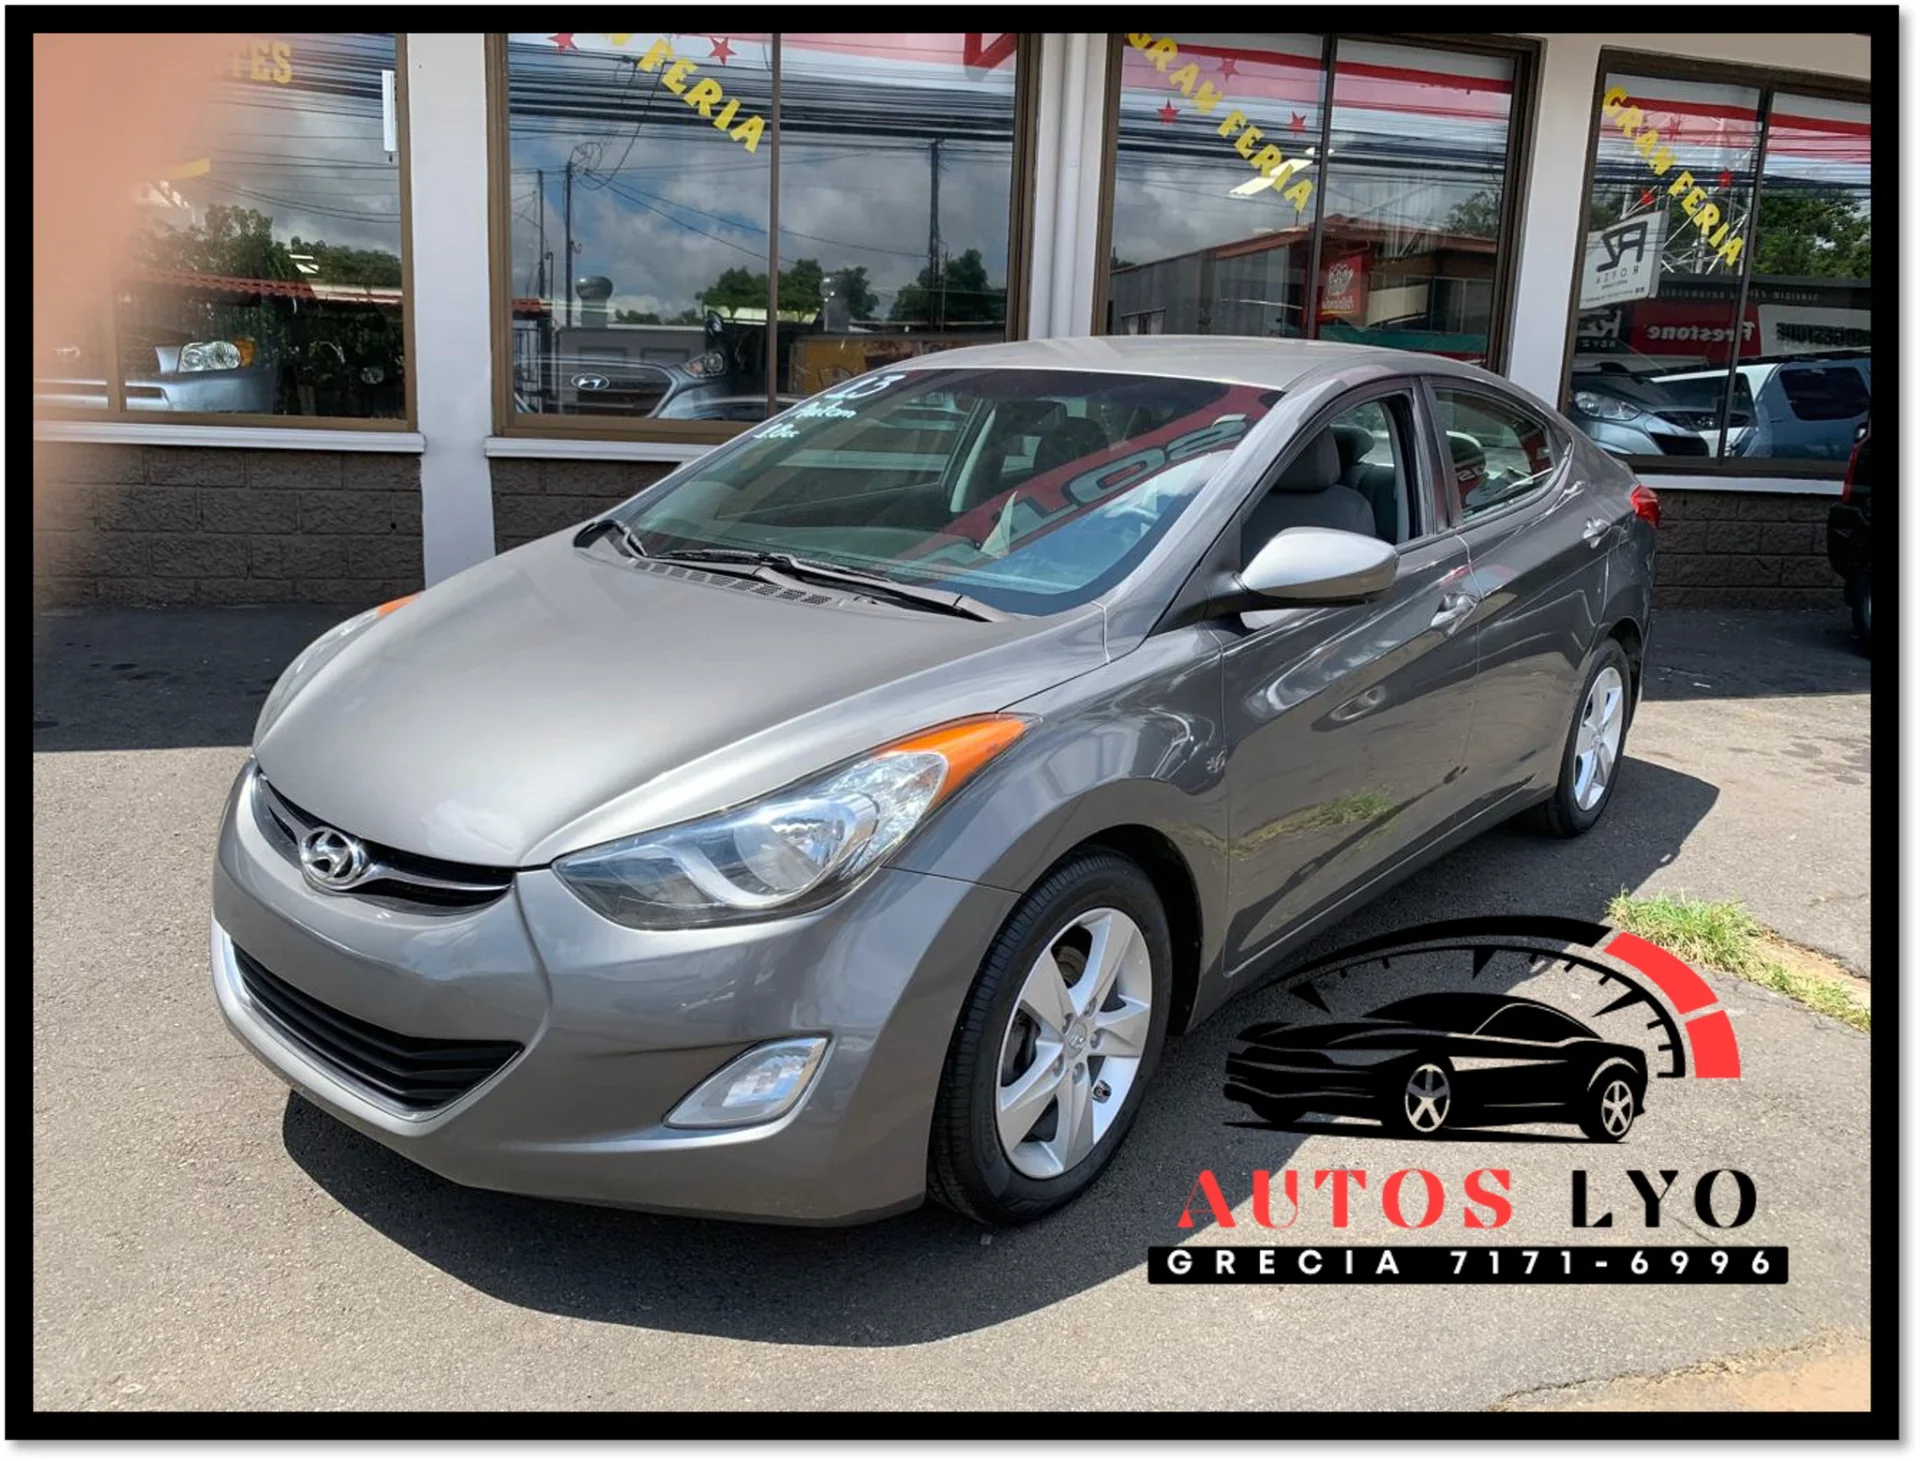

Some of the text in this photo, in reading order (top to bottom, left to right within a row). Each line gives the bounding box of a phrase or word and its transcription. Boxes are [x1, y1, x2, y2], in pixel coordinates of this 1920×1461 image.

[638, 37, 766, 154] FERIA
[1217, 109, 1315, 213] FERIA
[1602, 85, 1744, 267] GRAN FERIA
